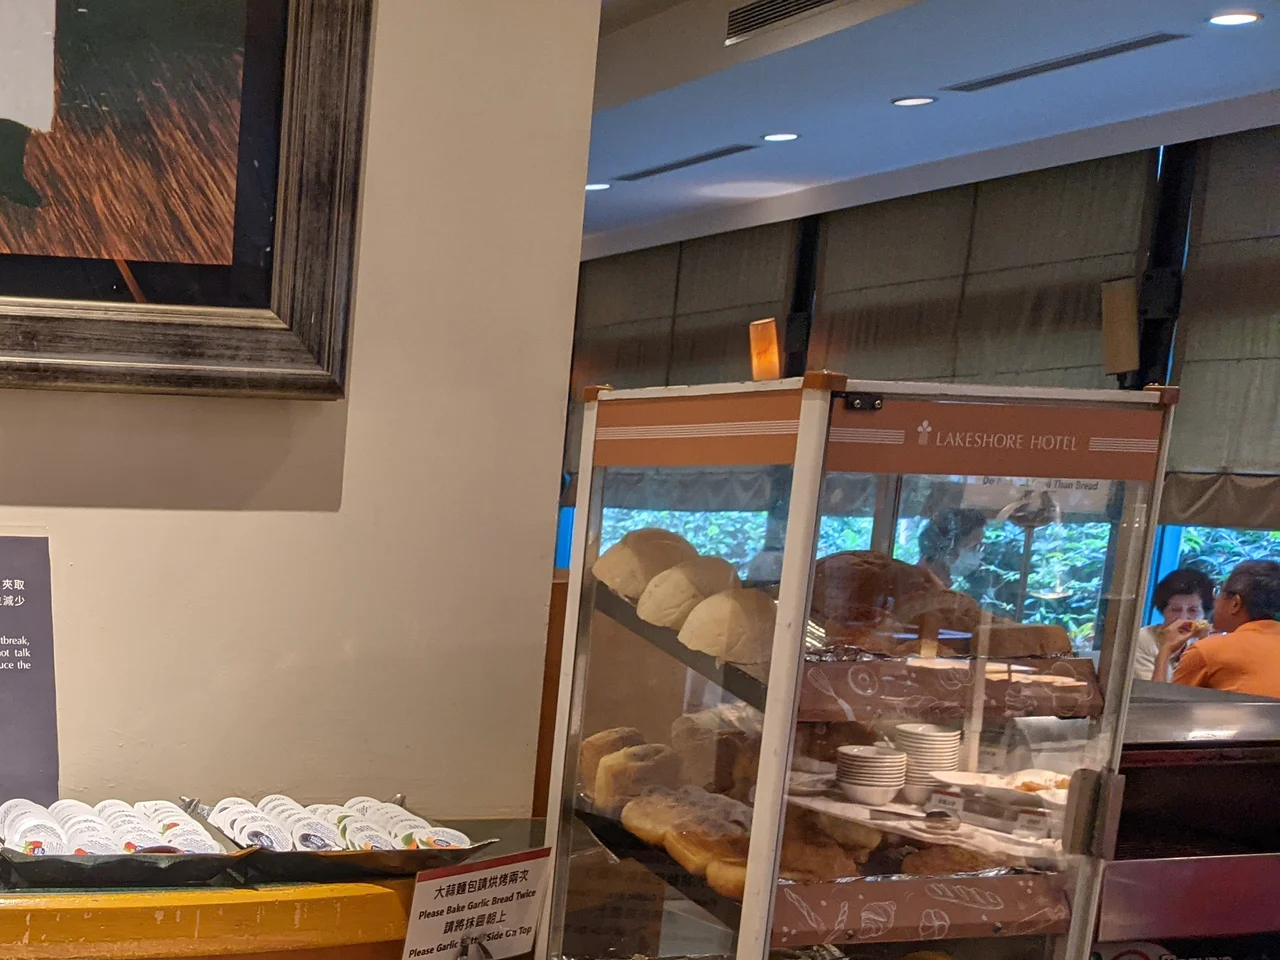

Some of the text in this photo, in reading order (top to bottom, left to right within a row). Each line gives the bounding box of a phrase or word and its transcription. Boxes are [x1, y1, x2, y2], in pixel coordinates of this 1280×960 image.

[935, 431, 1078, 451] LAKESHORE HOTEL
[14, 648, 31, 657] talk
[17, 660, 31, 669] the
[433, 869, 529, 899] 大蒜麵包請烘烤兩次
[418, 888, 536, 920] Please Bake Garlic Bread Twice
[408, 947, 435, 958] Please
[436, 940, 458, 952] Garlic
[486, 932, 503, 942] Side
[519, 925, 532, 936] Top
